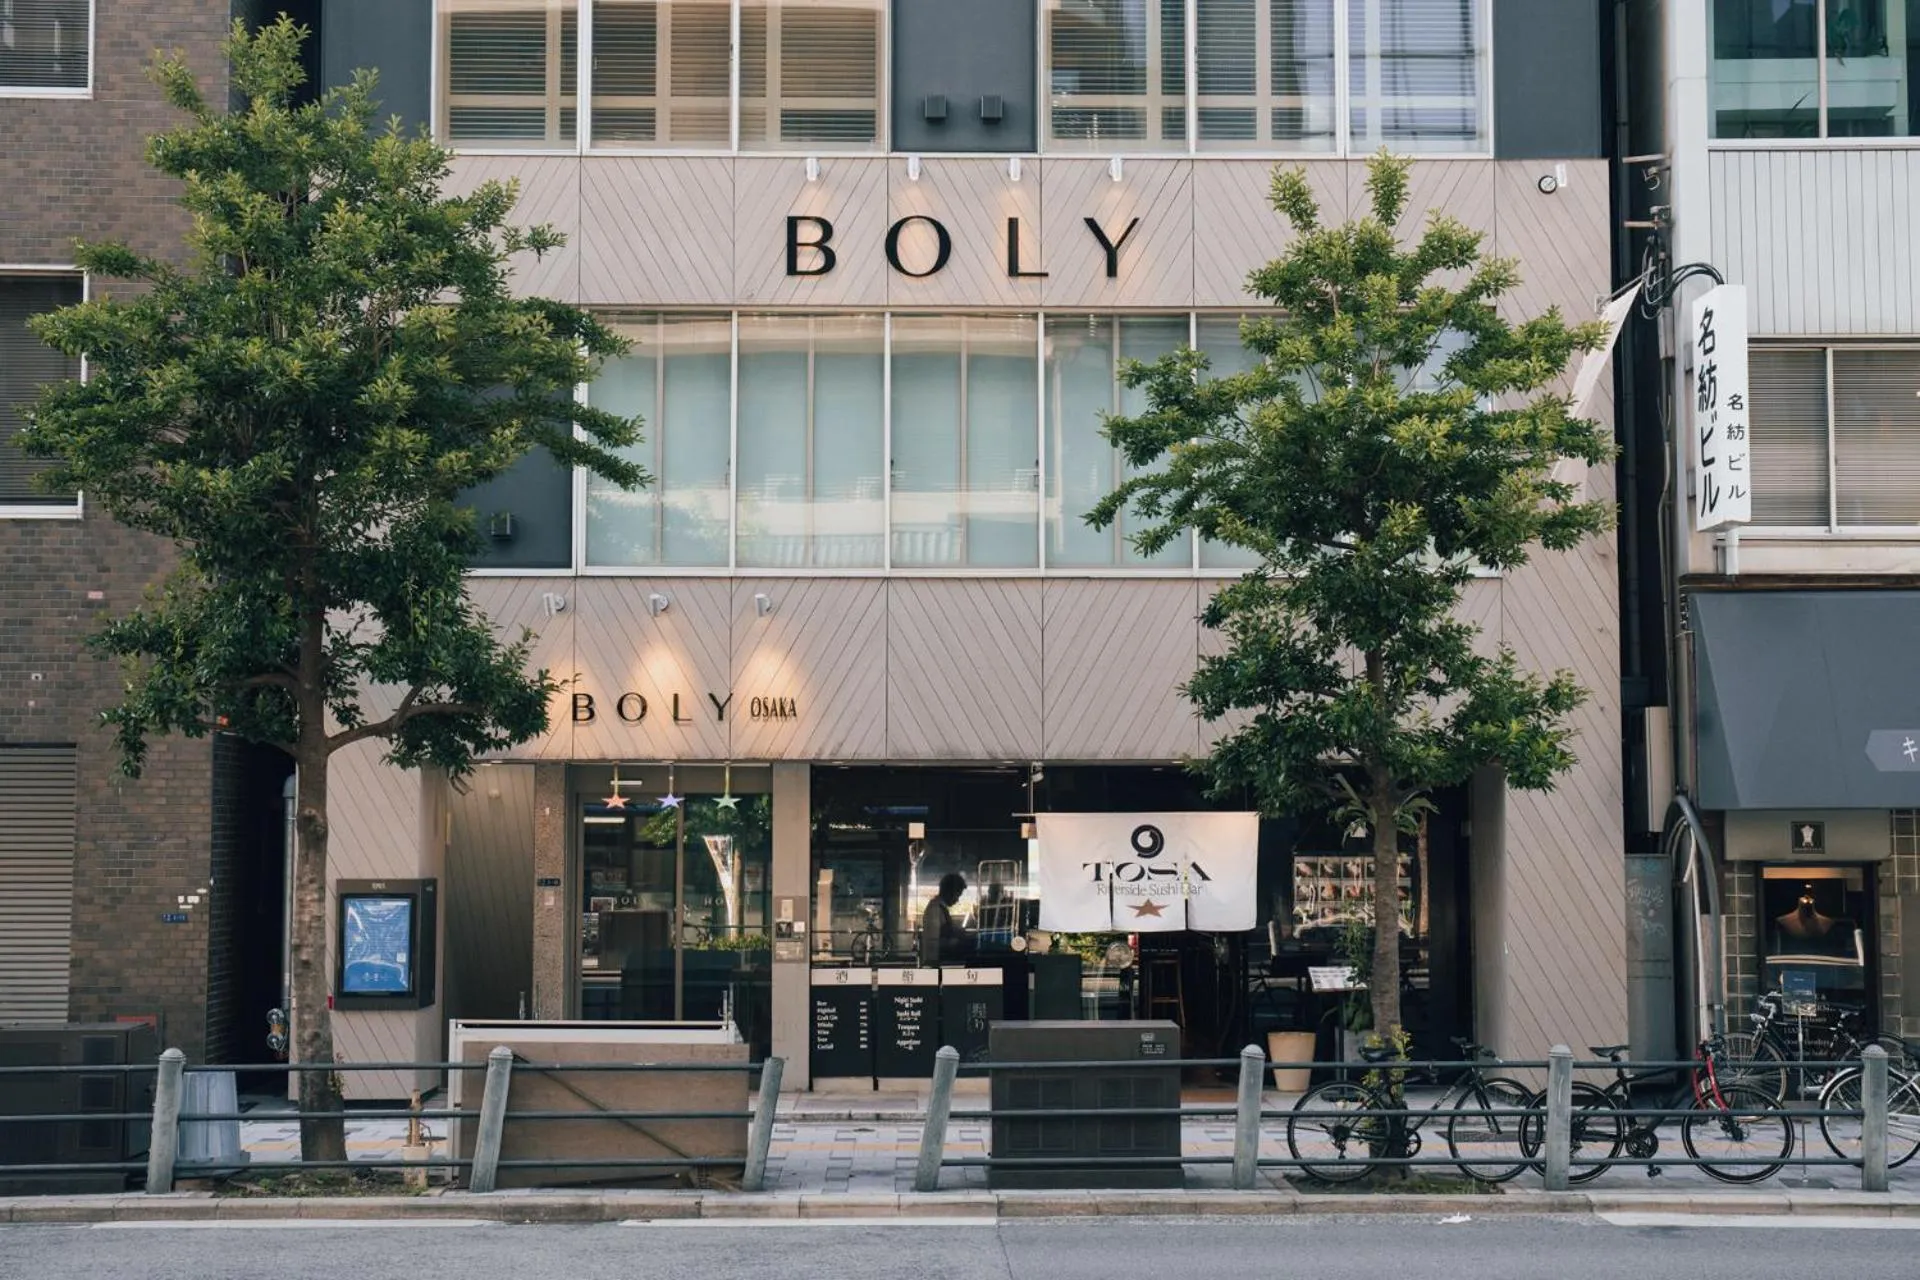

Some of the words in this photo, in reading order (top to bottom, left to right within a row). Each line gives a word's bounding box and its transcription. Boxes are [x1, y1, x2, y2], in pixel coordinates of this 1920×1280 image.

[786, 215, 1141, 279] BOLY
[1697, 305, 1720, 518] 名紡ビル
[1726, 393, 1746, 500] 名紡ビル
[572, 692, 733, 723] BOLY
[750, 695, 797, 719] OSAKA
[1902, 736, 1919, 763] キ
[1082, 861, 1212, 883] TOSA
[1149, 883, 1178, 896] Sushi
